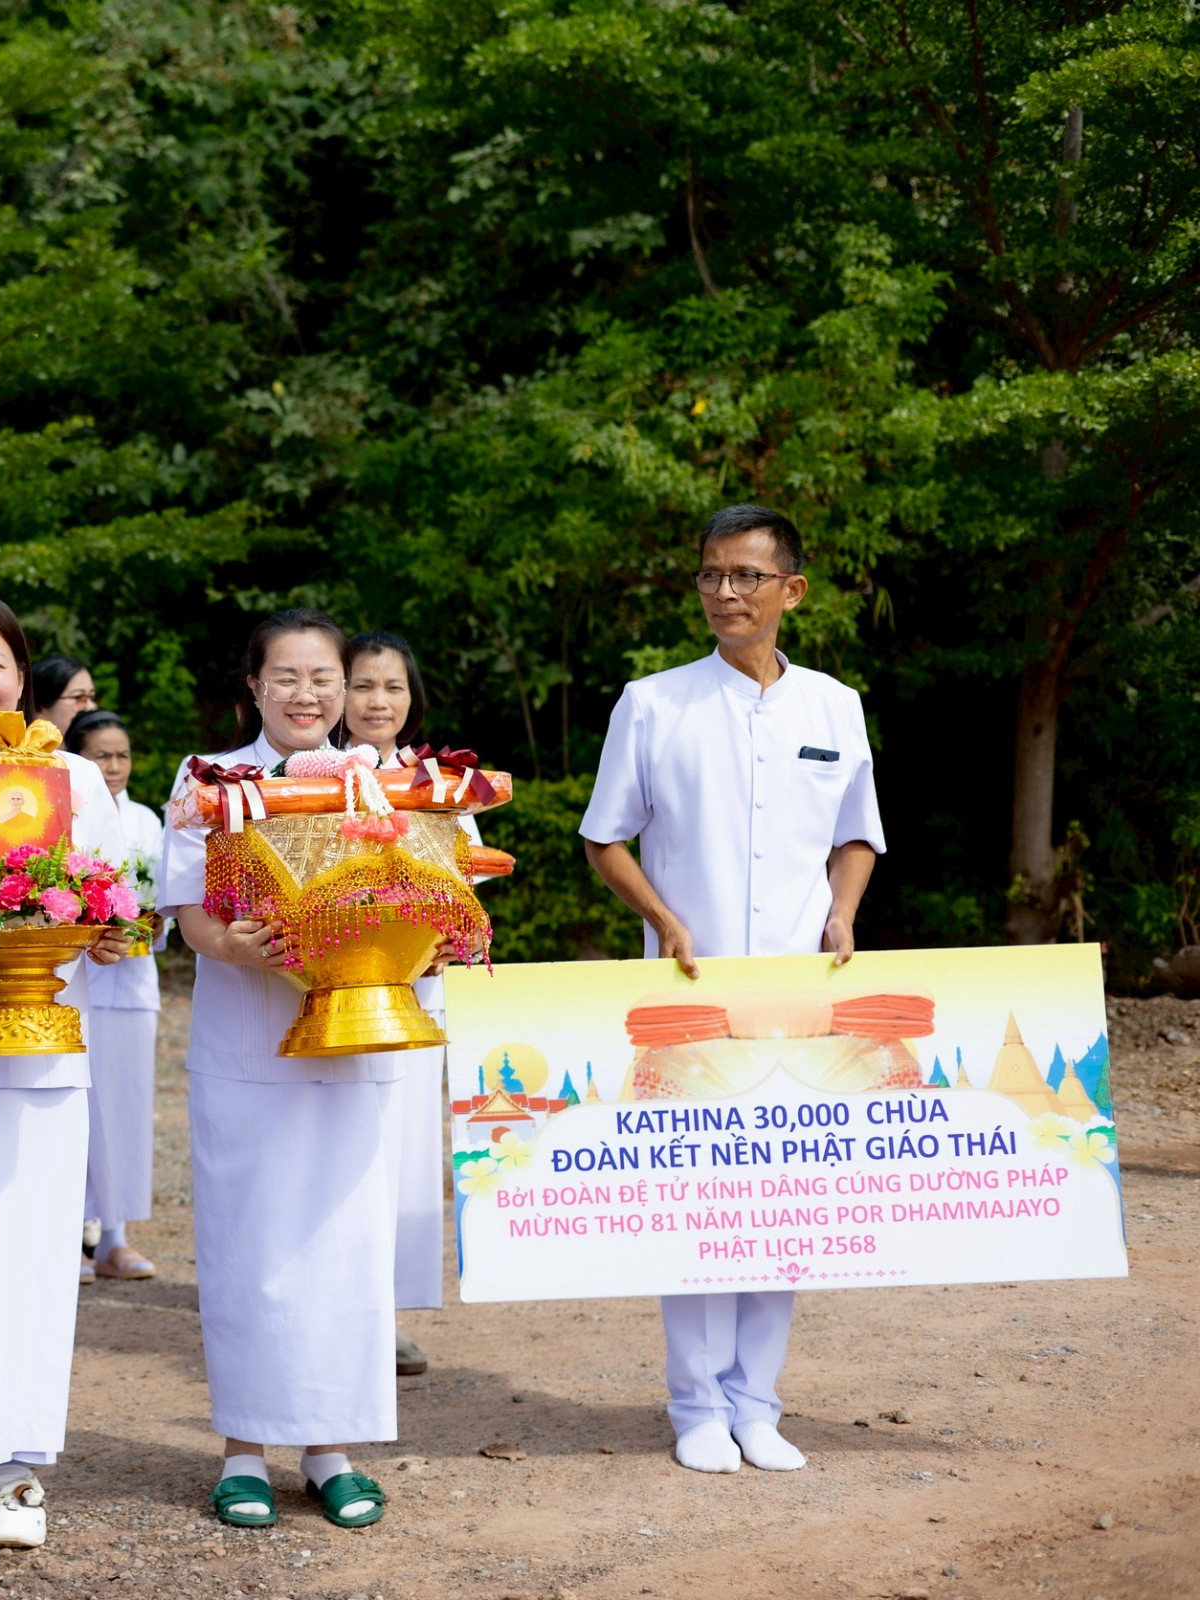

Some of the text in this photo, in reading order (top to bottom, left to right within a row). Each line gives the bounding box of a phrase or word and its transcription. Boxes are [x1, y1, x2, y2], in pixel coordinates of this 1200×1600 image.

[616, 1094, 949, 1135] KATHINA 30,000 CHÙA
[551, 1125, 1017, 1173] ĐOÀN KẾT NỀN PHẬT GIÁO THÁI
[542, 1180, 611, 1207] ĐOÀN
[618, 1179, 649, 1207] ĐỆ
[655, 1175, 690, 1202] TỬ
[697, 1176, 753, 1200] KÍNH
[761, 1174, 828, 1198] DÂNG
[835, 1171, 902, 1195] CÚNG
[909, 1167, 1000, 1192] DƯỜNG
[1007, 1163, 1069, 1188] PHÁP
[509, 1197, 1061, 1238] MỪNG THỌ 81 NĂM LUANG POR DHAMMAJAYO
[698, 1235, 877, 1263] PHẬT LỊCH 2568
